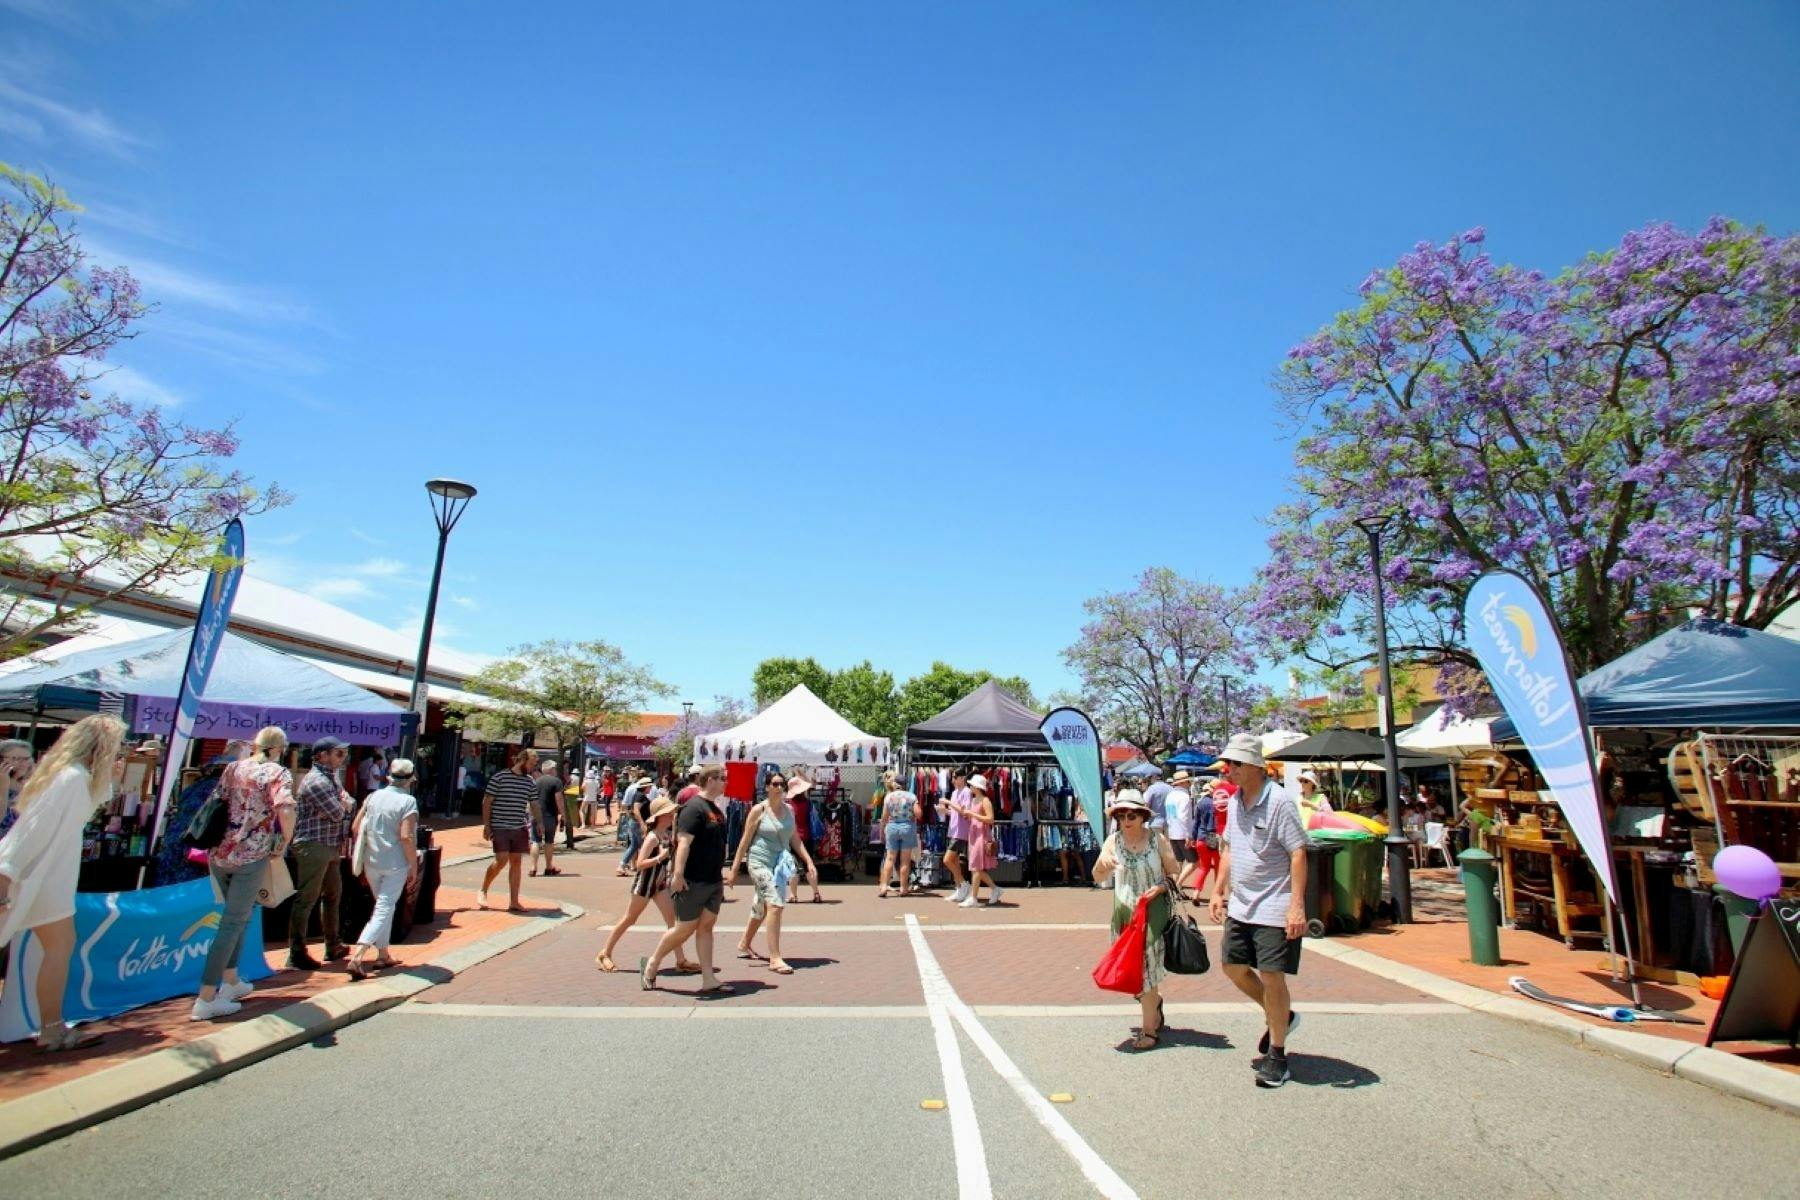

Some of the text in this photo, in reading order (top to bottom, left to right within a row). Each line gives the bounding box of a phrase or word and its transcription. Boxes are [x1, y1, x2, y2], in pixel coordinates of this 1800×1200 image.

[142, 706, 395, 740] Stuby holders with bling!
[118, 934, 214, 981] lotteryw
